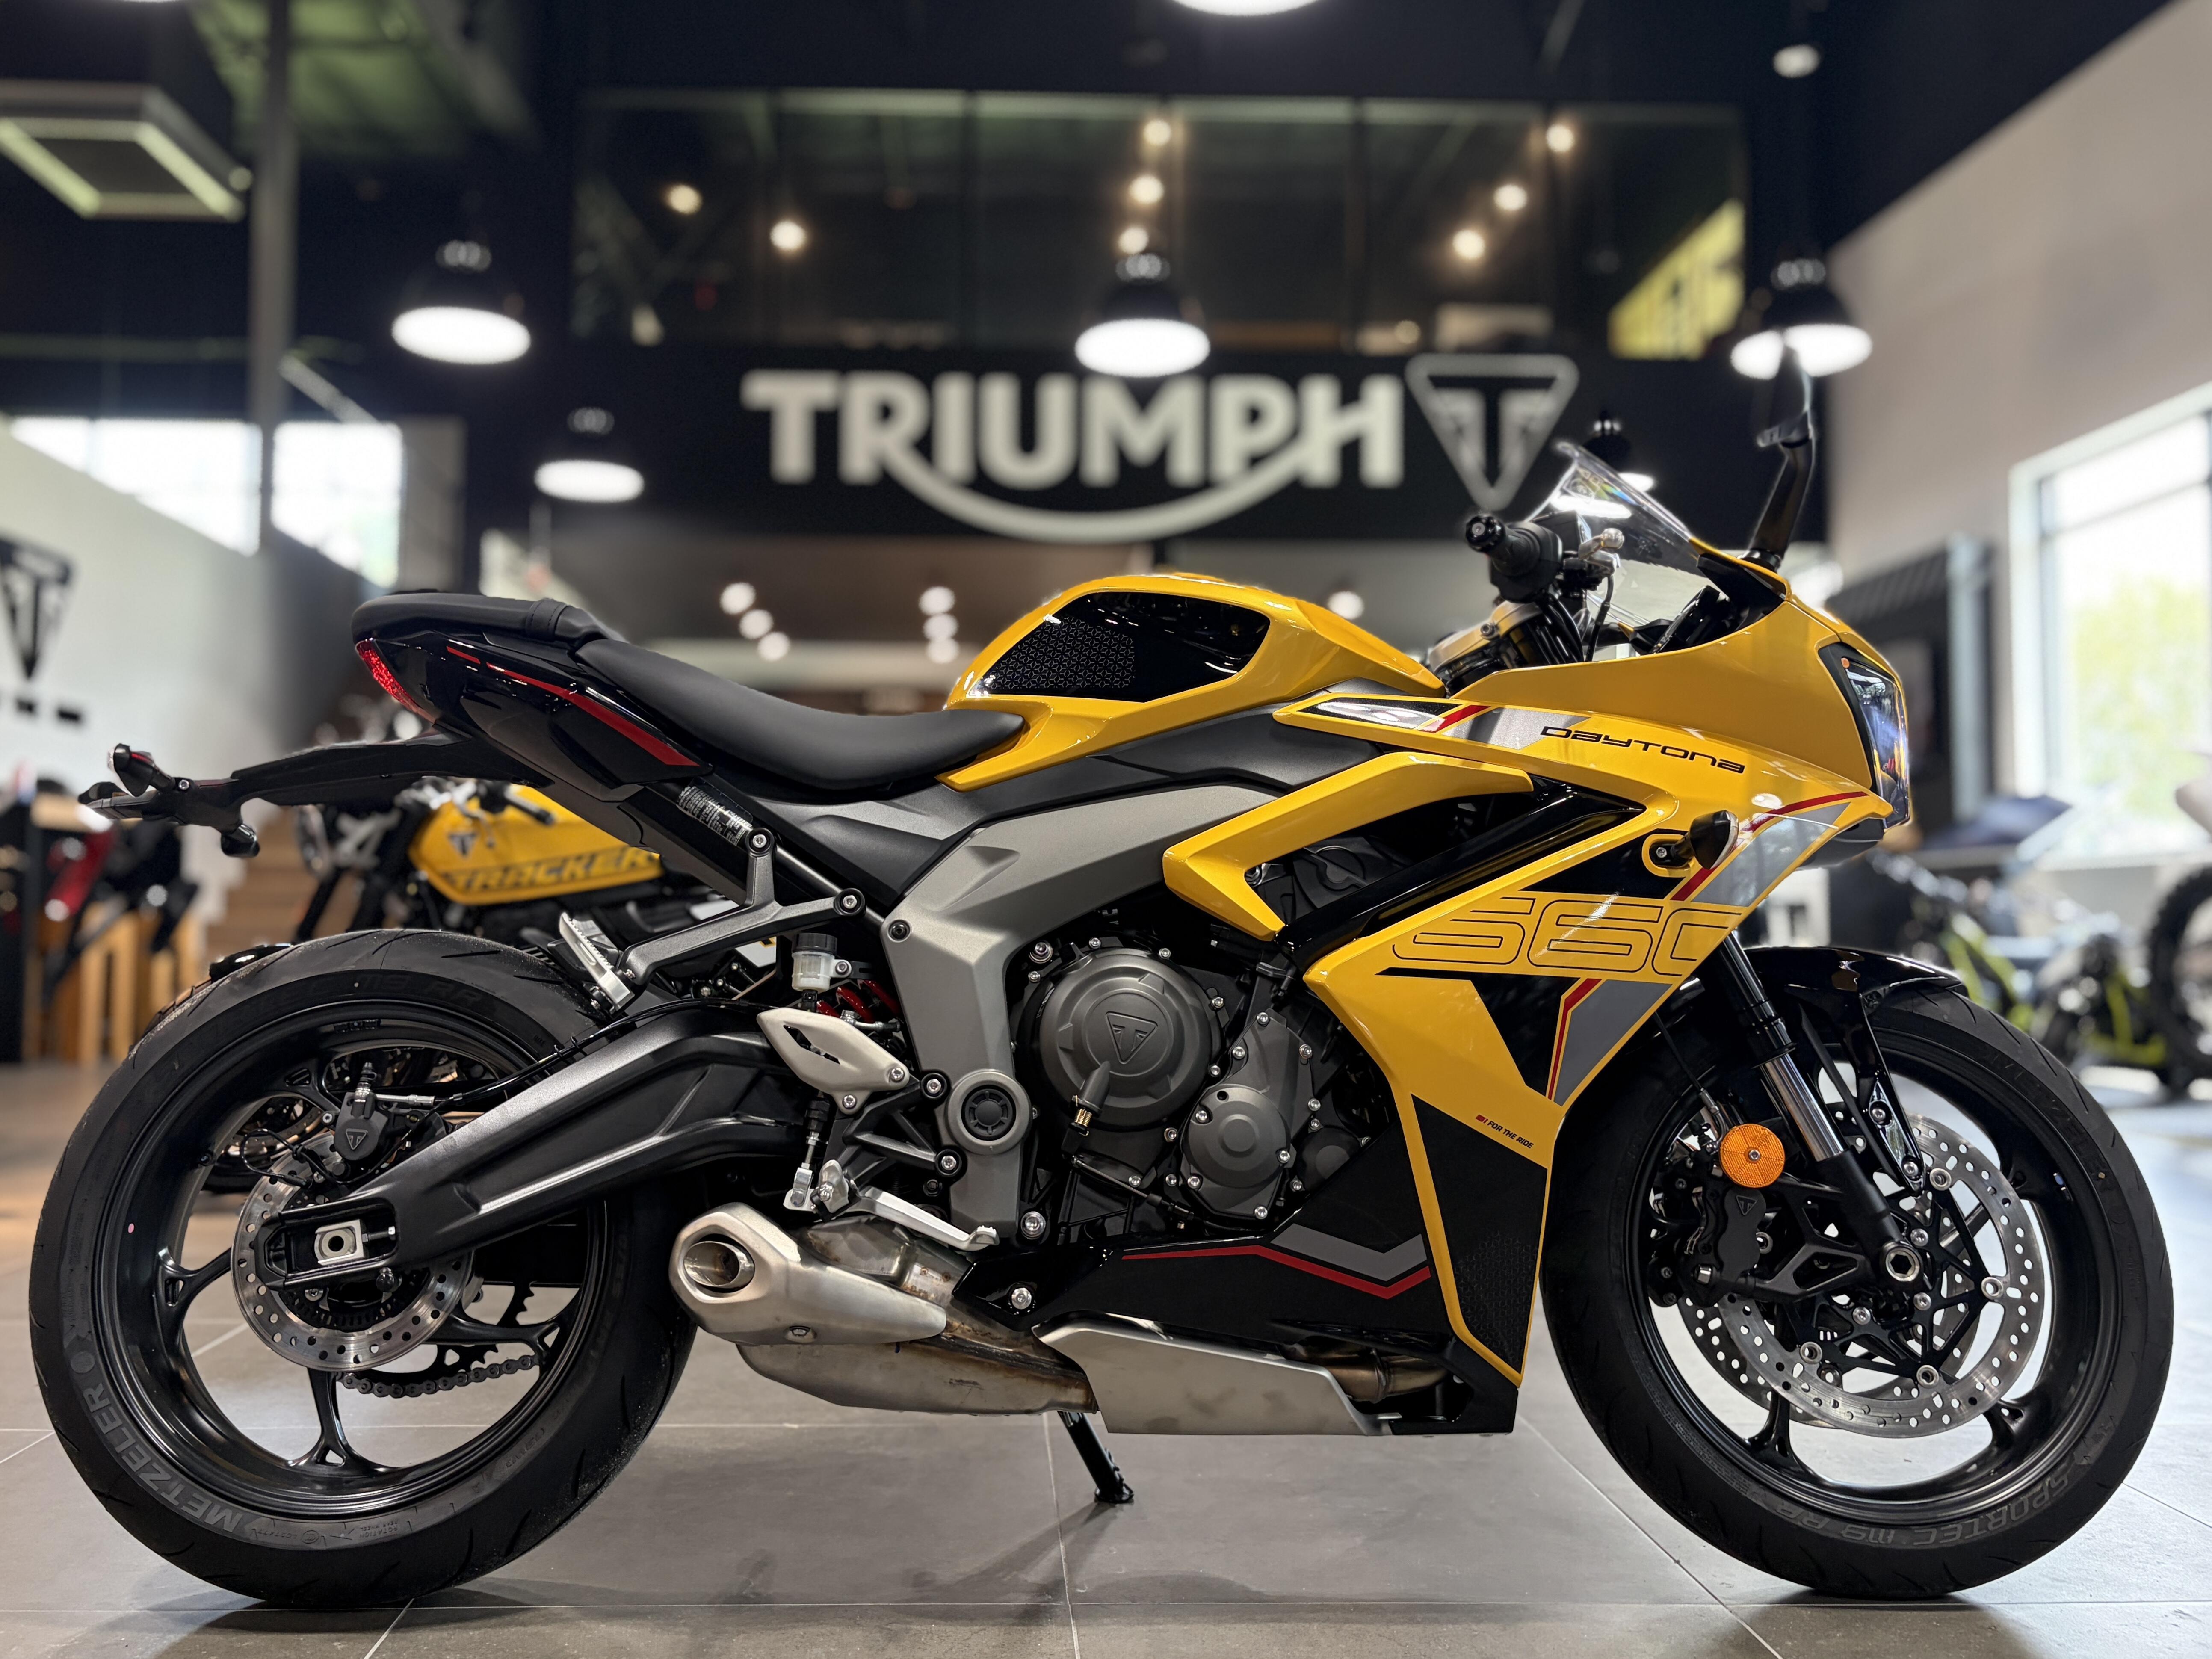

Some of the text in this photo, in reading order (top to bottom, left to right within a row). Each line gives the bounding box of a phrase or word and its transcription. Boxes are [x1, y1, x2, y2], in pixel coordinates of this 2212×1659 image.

[741, 369, 1405, 543] TRIUMPH
[1487, 1121, 1534, 1149] FOR THE RIDE
[83, 1382, 243, 1533] METZELER
[1914, 1473, 2070, 1545] SPORTEC
